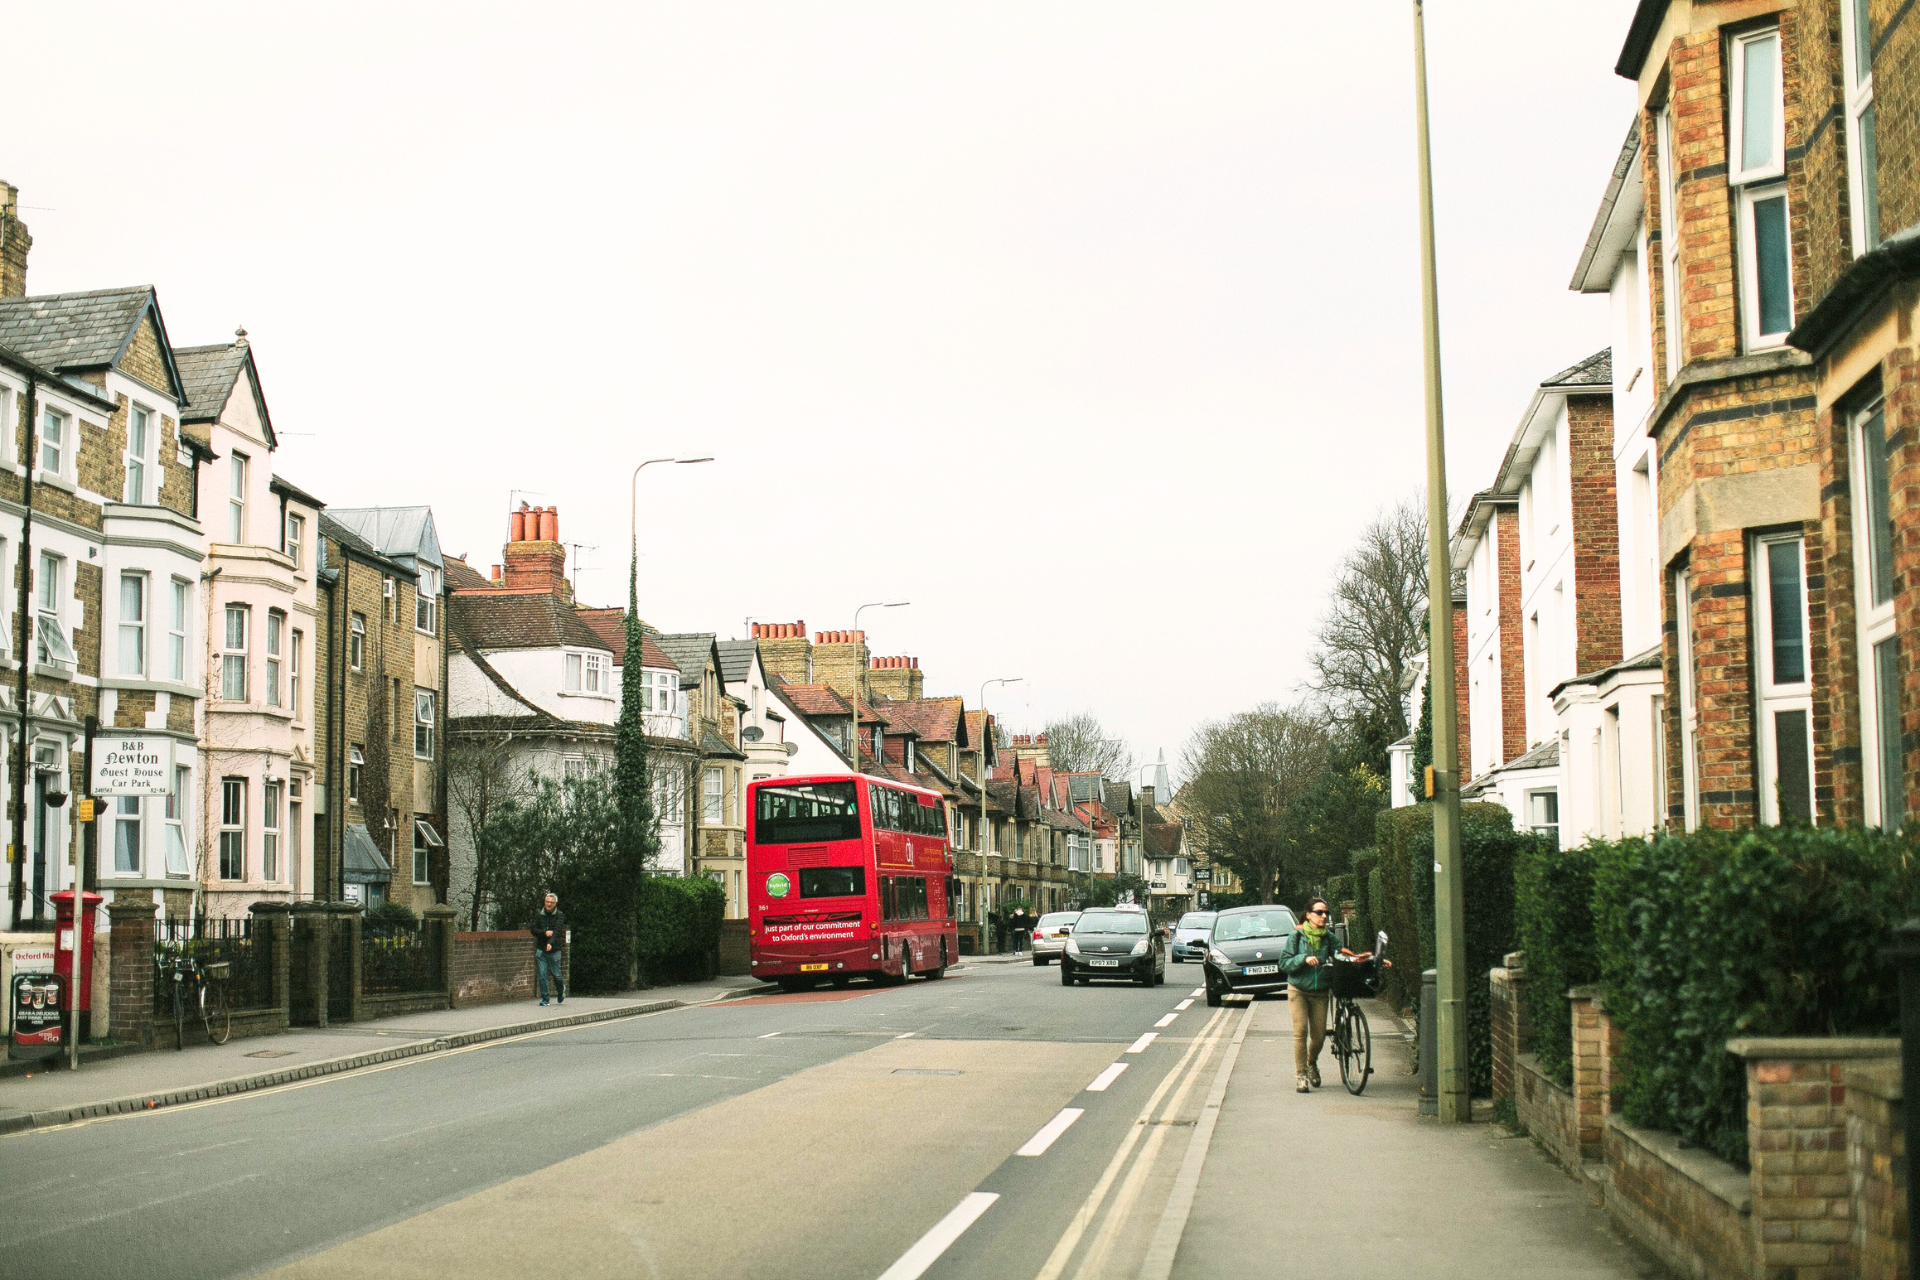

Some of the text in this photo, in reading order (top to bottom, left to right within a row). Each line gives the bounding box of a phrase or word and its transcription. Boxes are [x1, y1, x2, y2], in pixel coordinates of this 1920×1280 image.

[122, 741, 144, 751] B&B
[104, 752, 158, 765] Newton
[100, 767, 163, 777] Guest House
[112, 779, 151, 787] Car Park
[765, 925, 778, 934] just
[779, 924, 793, 933] part
[794, 923, 802, 931] of
[816, 921, 860, 930] commitment
[780, 933, 808, 941] Oxford's
[810, 931, 854, 940] environment
[15, 952, 41, 960] Oxford
